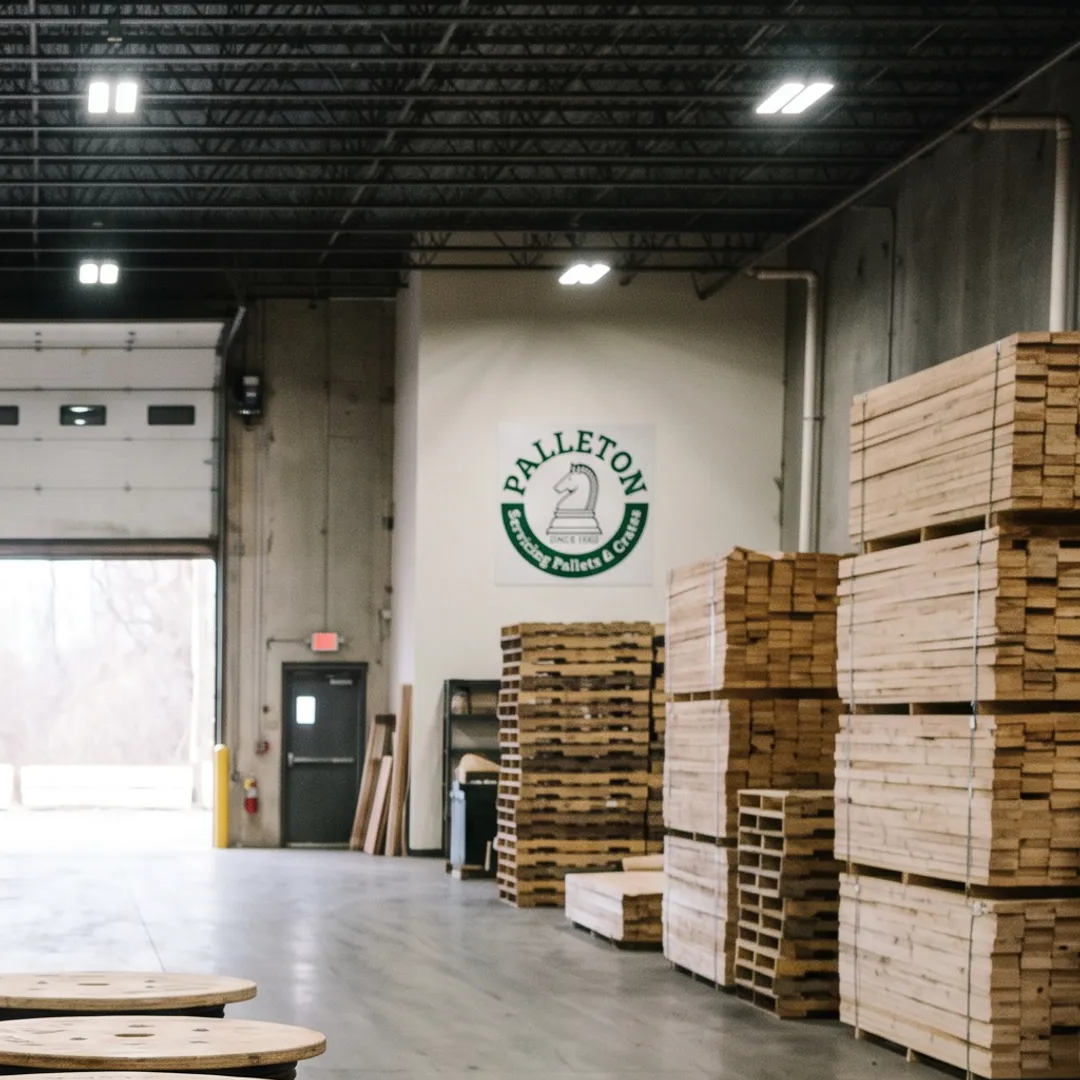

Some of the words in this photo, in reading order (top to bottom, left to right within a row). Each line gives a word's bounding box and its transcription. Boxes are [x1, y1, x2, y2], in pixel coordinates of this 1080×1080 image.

[503, 429, 648, 496] PALLETON
[507, 509, 552, 569] Servicing
[552, 556, 603, 573] Pallets
